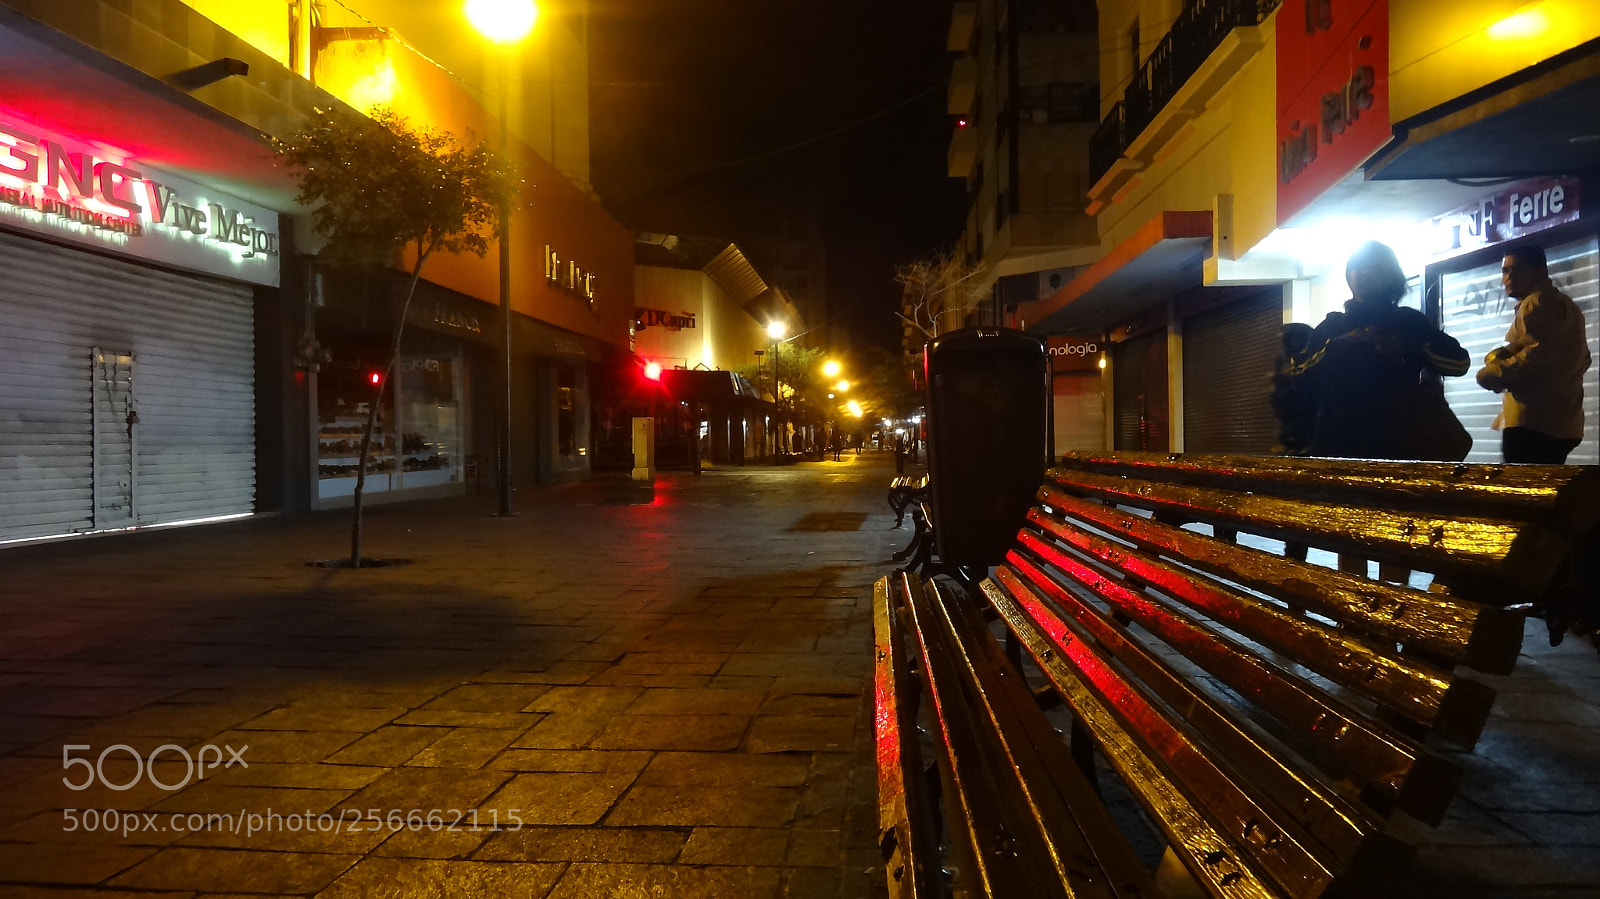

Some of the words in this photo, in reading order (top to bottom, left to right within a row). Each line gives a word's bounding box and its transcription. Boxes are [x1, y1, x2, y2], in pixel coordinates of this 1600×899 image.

[0, 124, 142, 213] GNC
[1509, 185, 1564, 228] Ferre
[150, 180, 207, 235] Vive
[209, 203, 279, 258] Mejor
